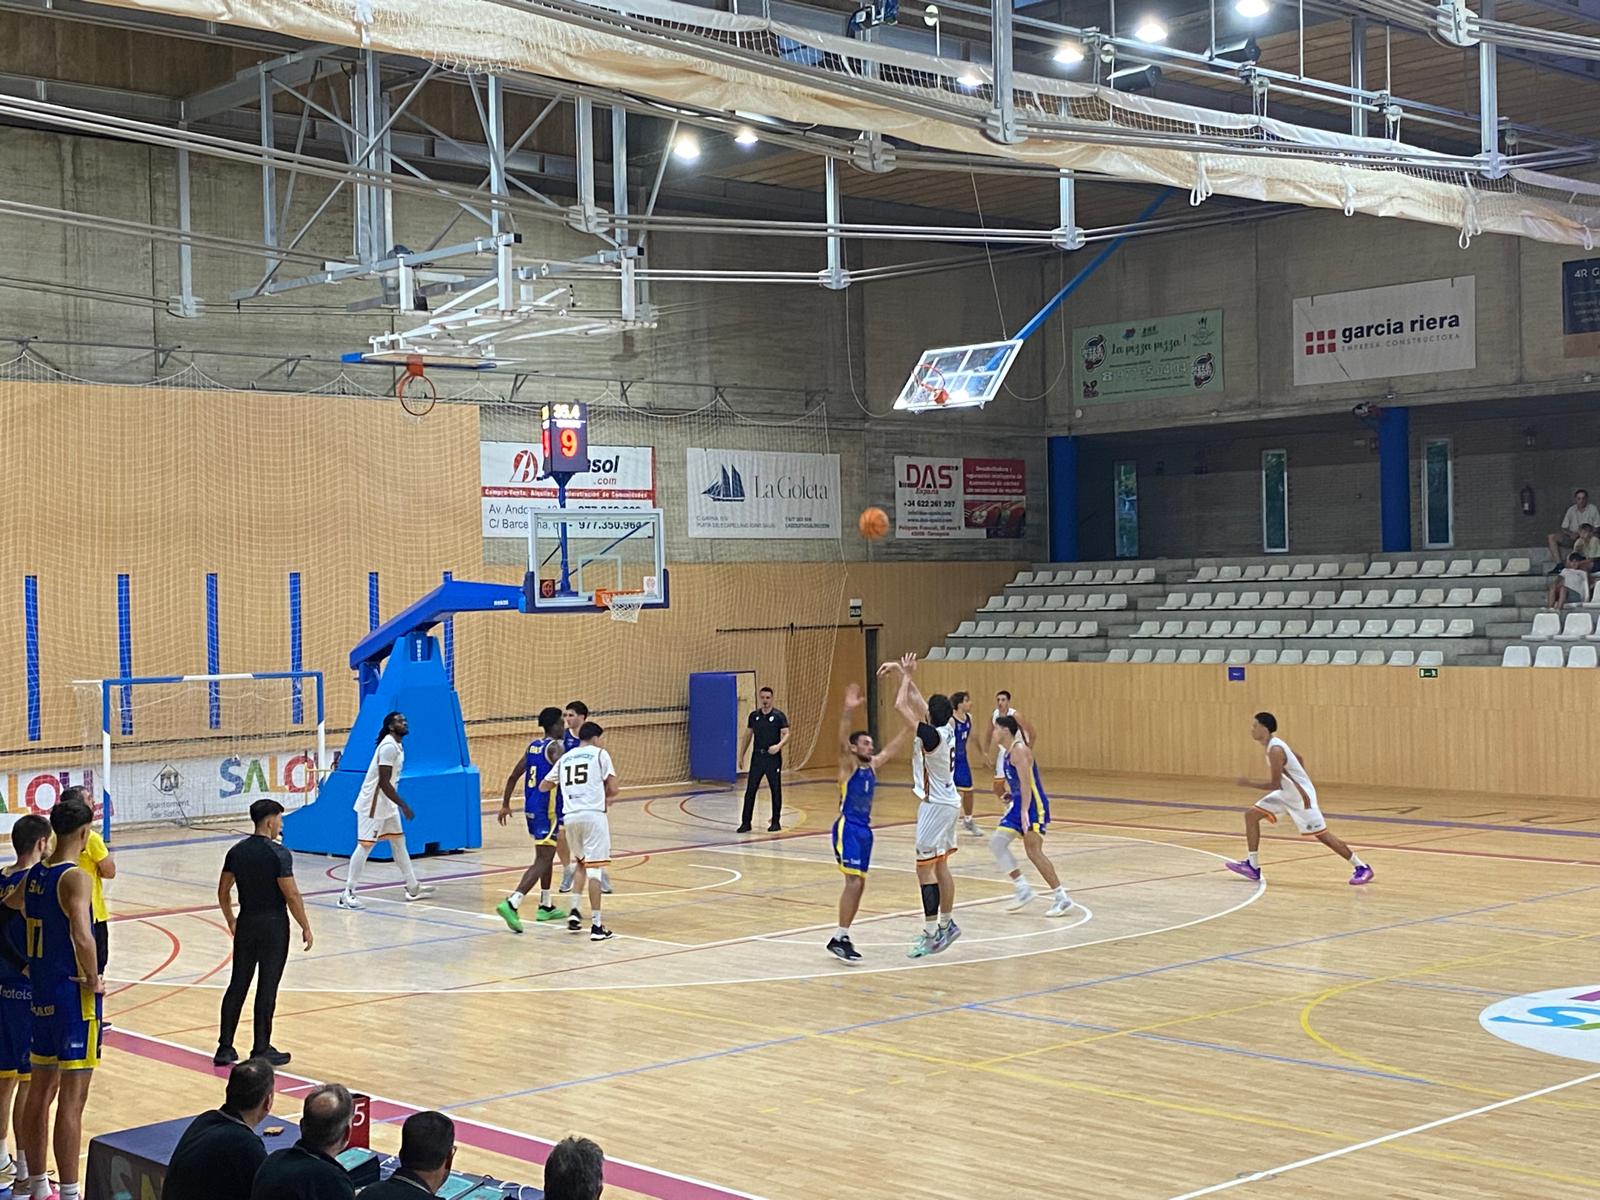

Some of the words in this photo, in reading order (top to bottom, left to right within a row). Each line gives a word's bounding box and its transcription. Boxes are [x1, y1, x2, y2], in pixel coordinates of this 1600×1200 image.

[1342, 318, 1404, 343] garcia
[1410, 314, 1460, 332] riera
[1386, 333, 1460, 347] CONSTRUCTORA
[1125, 344, 1151, 356] pizza
[1153, 338, 1181, 353] pizza
[561, 429, 578, 457] 9
[593, 477, 617, 485] .com
[755, 475, 774, 499] La
[777, 476, 828, 500] Goleta
[900, 464, 957, 488] DAS
[527, 766, 537, 789] 3
[564, 763, 589, 786] 15
